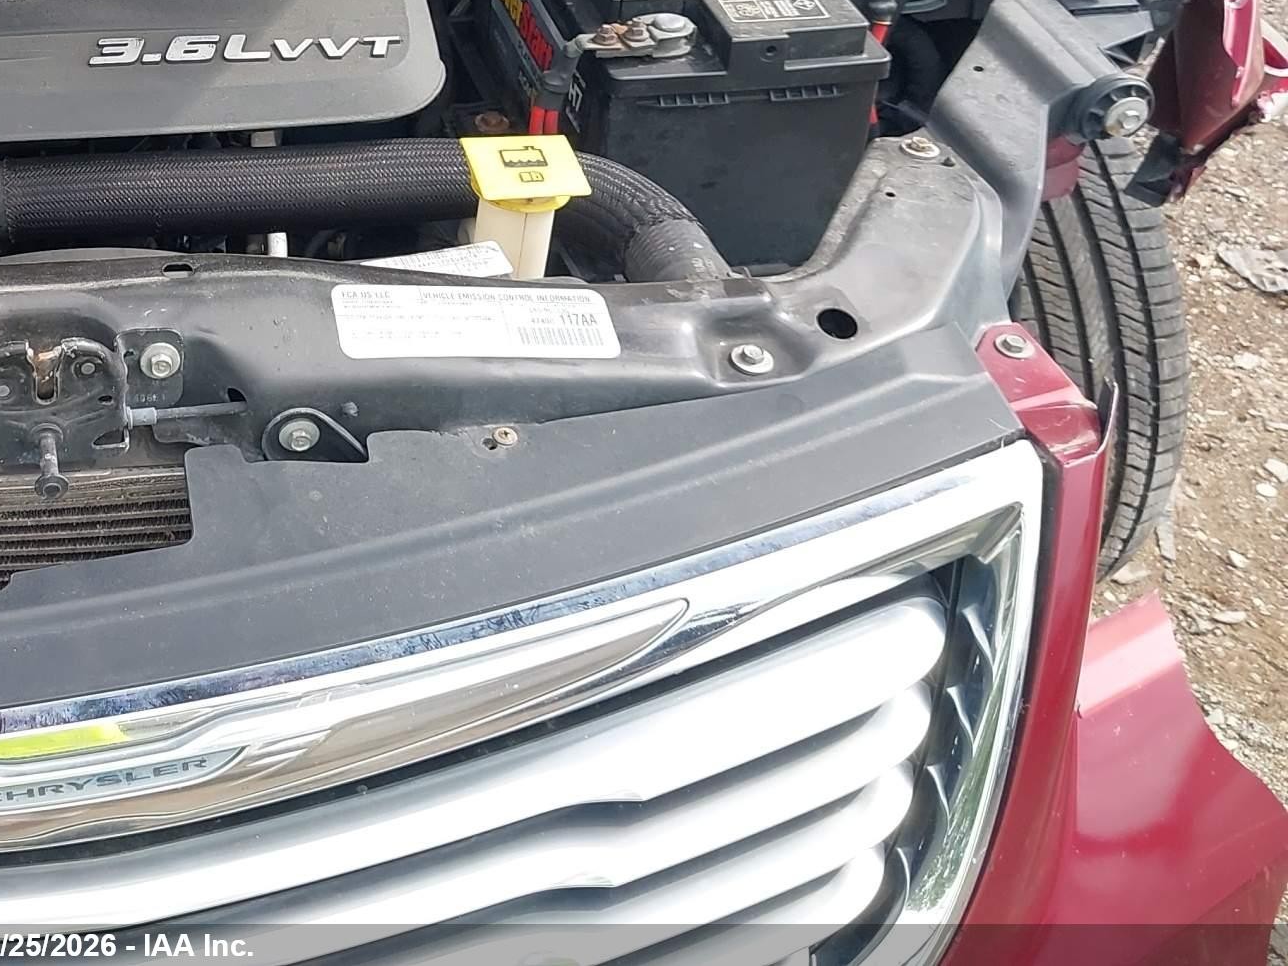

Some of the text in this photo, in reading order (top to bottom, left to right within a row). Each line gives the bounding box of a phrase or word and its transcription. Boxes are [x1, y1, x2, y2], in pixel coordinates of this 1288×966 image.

[421, 292, 591, 303] VEHICLE EMISSION CONTROL INFORMATION
[560, 314, 598, 326] 117AA
